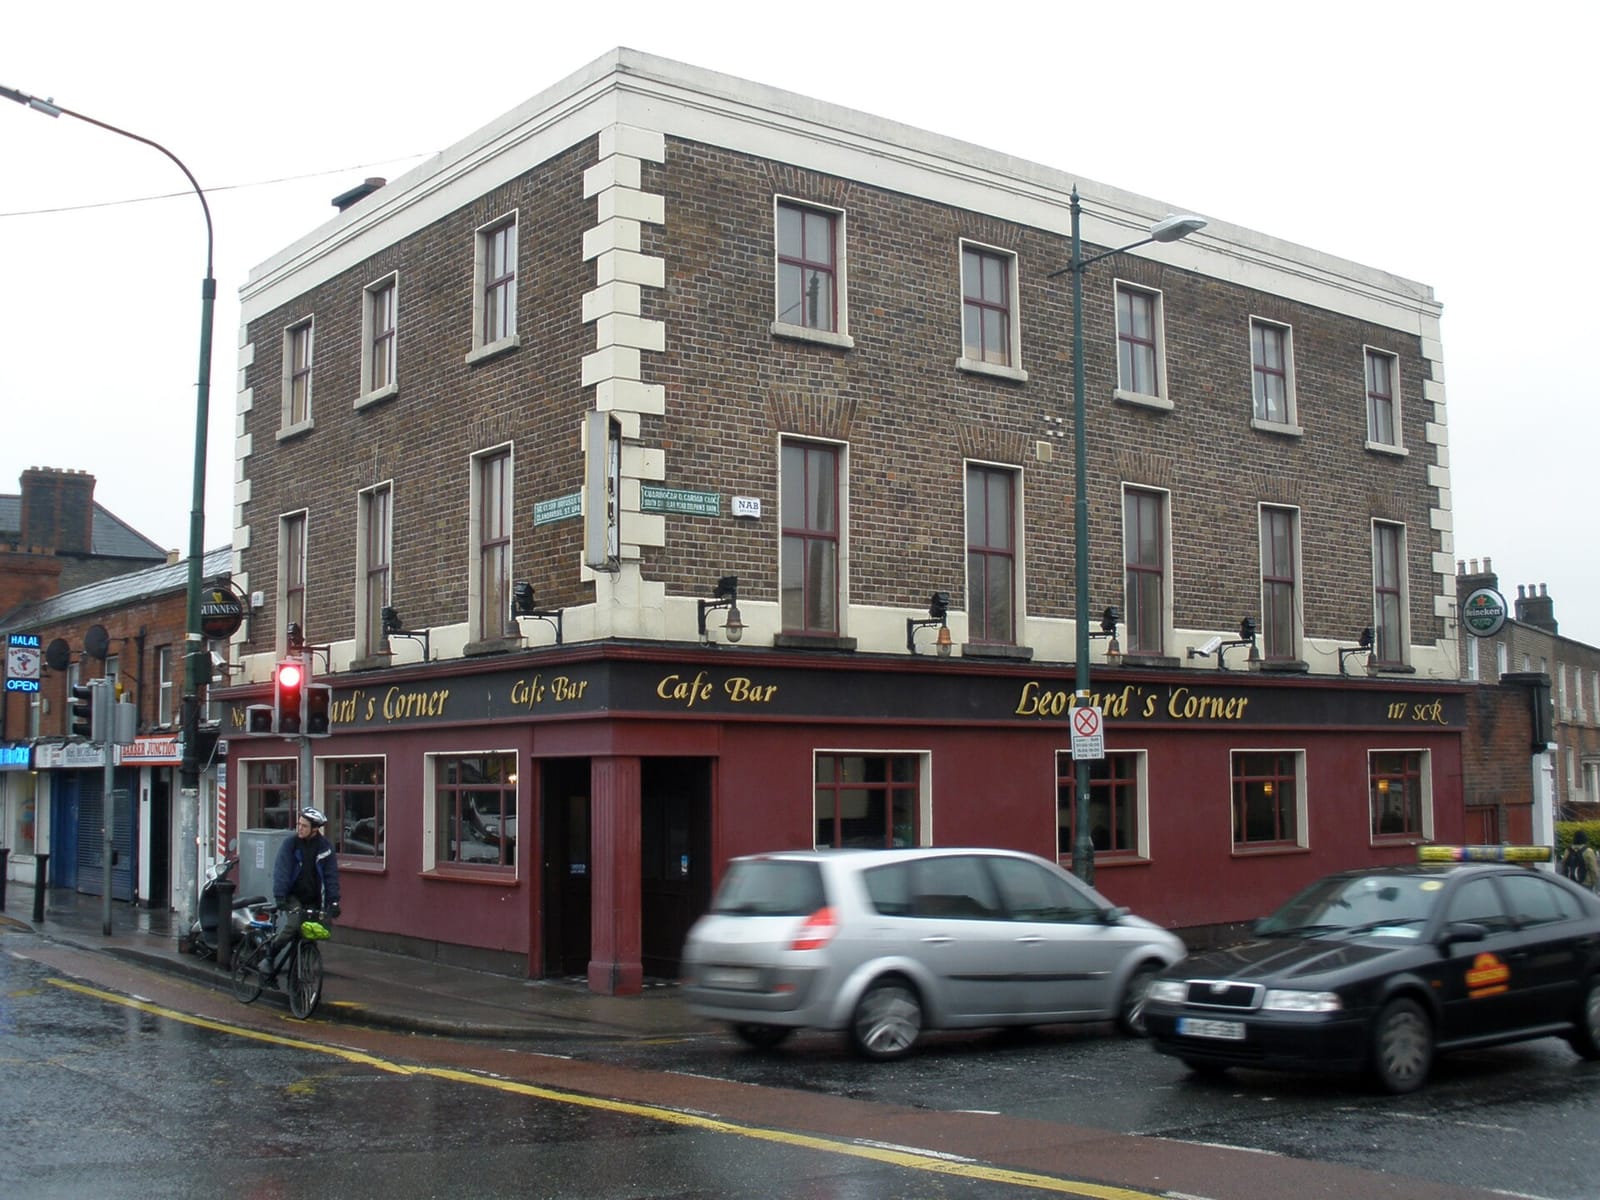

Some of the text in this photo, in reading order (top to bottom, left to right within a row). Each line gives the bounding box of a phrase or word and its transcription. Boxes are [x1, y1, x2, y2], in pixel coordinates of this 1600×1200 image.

[738, 500, 759, 510] NAB
[11, 635, 39, 646] HALAL
[7, 680, 39, 691] OPEN
[510, 673, 588, 712] Cafe Bar
[656, 670, 778, 708] Cafe Bar
[383, 686, 450, 720] Corner
[1168, 687, 1249, 719] Corner
[1387, 697, 1449, 725] 117 SCR
[146, 741, 177, 755] JUNCTION
